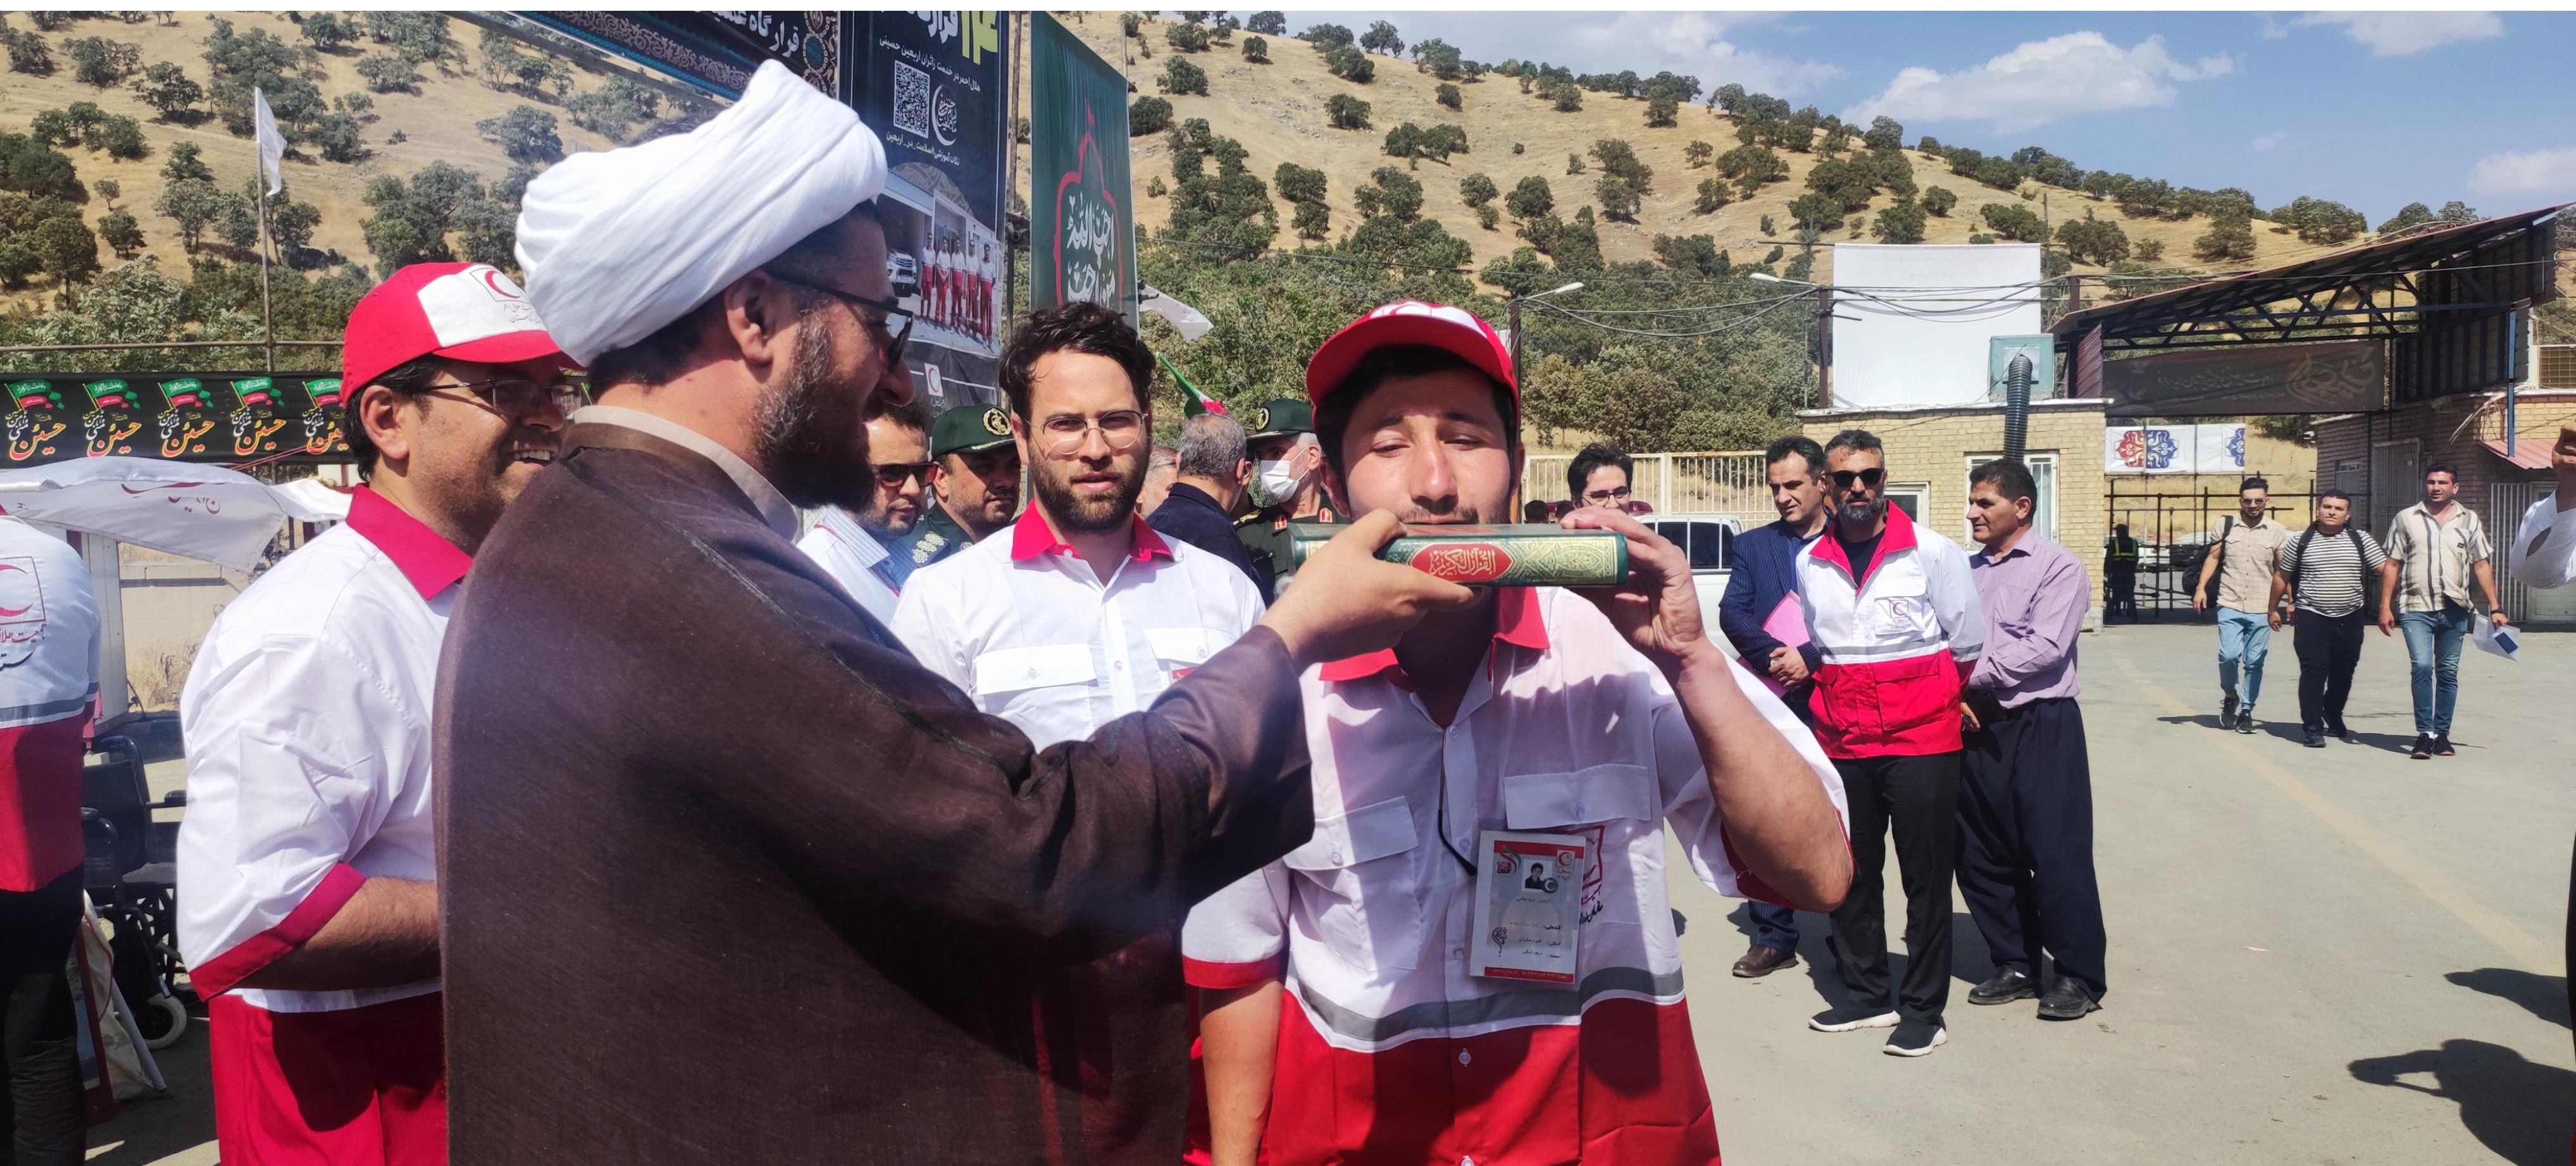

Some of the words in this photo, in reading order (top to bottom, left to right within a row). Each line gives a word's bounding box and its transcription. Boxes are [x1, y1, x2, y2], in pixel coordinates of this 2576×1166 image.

[879, 35, 900, 50] حسینی
[901, 46, 921, 63] اربعین
[921, 54, 936, 70] زائران
[936, 62, 953, 75] خدمت
[953, 72, 959, 82] در
[959, 77, 970, 87] احمر
[970, 79, 981, 92] هلال
[933, 148, 950, 164] آموزشی
[5, 408, 23, 420] حسین
[83, 408, 100, 419] حسین
[158, 407, 174, 419] حسین
[230, 406, 246, 417] حسین
[302, 406, 319, 417] حسین
[9, 422, 67, 461] حسین
[87, 421, 142, 458] حسین
[161, 420, 215, 458] حسین
[235, 419, 287, 456] حسین
[1458, 547, 1496, 575] القرآن
